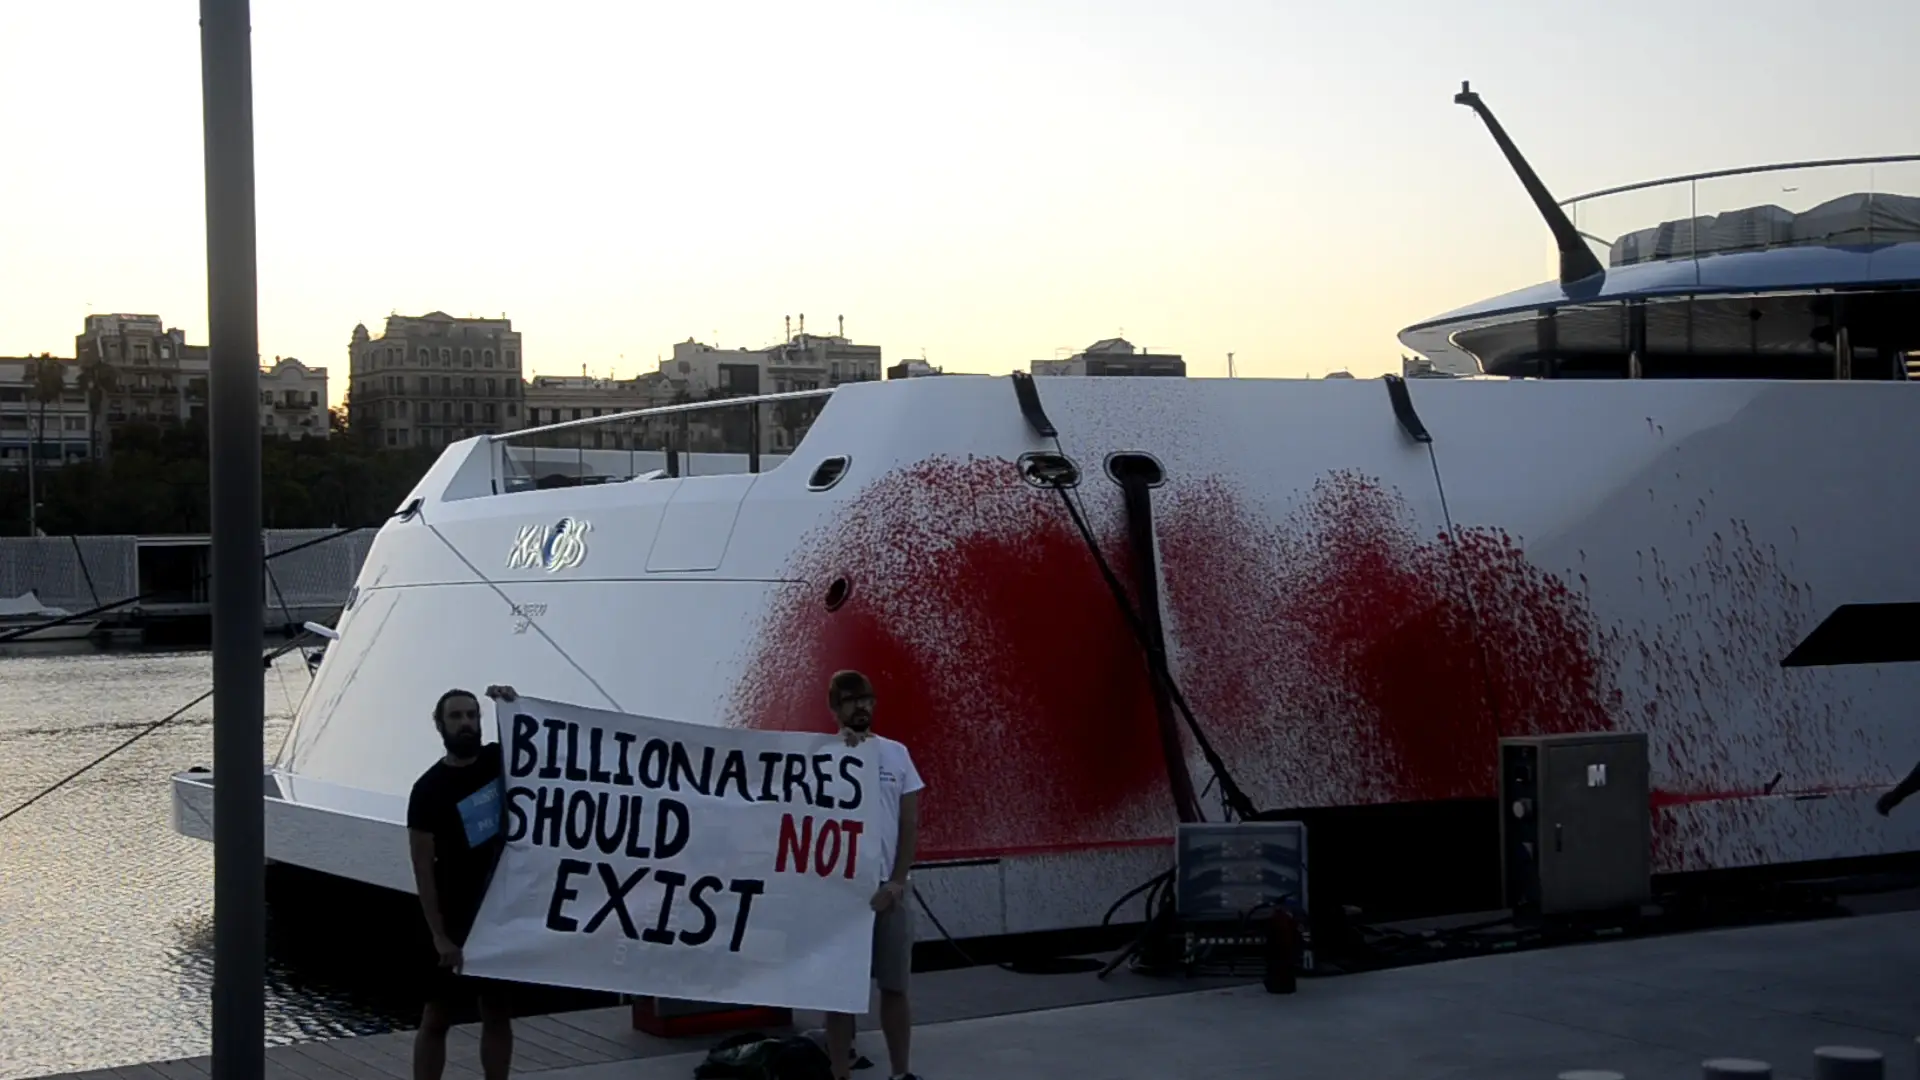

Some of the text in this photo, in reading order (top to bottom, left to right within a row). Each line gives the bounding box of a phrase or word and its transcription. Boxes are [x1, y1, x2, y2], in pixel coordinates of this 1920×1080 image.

[510, 714, 864, 810] BILLIONAIRES
[506, 786, 864, 879] SHOULD NOT
[546, 858, 765, 952] EXIST
